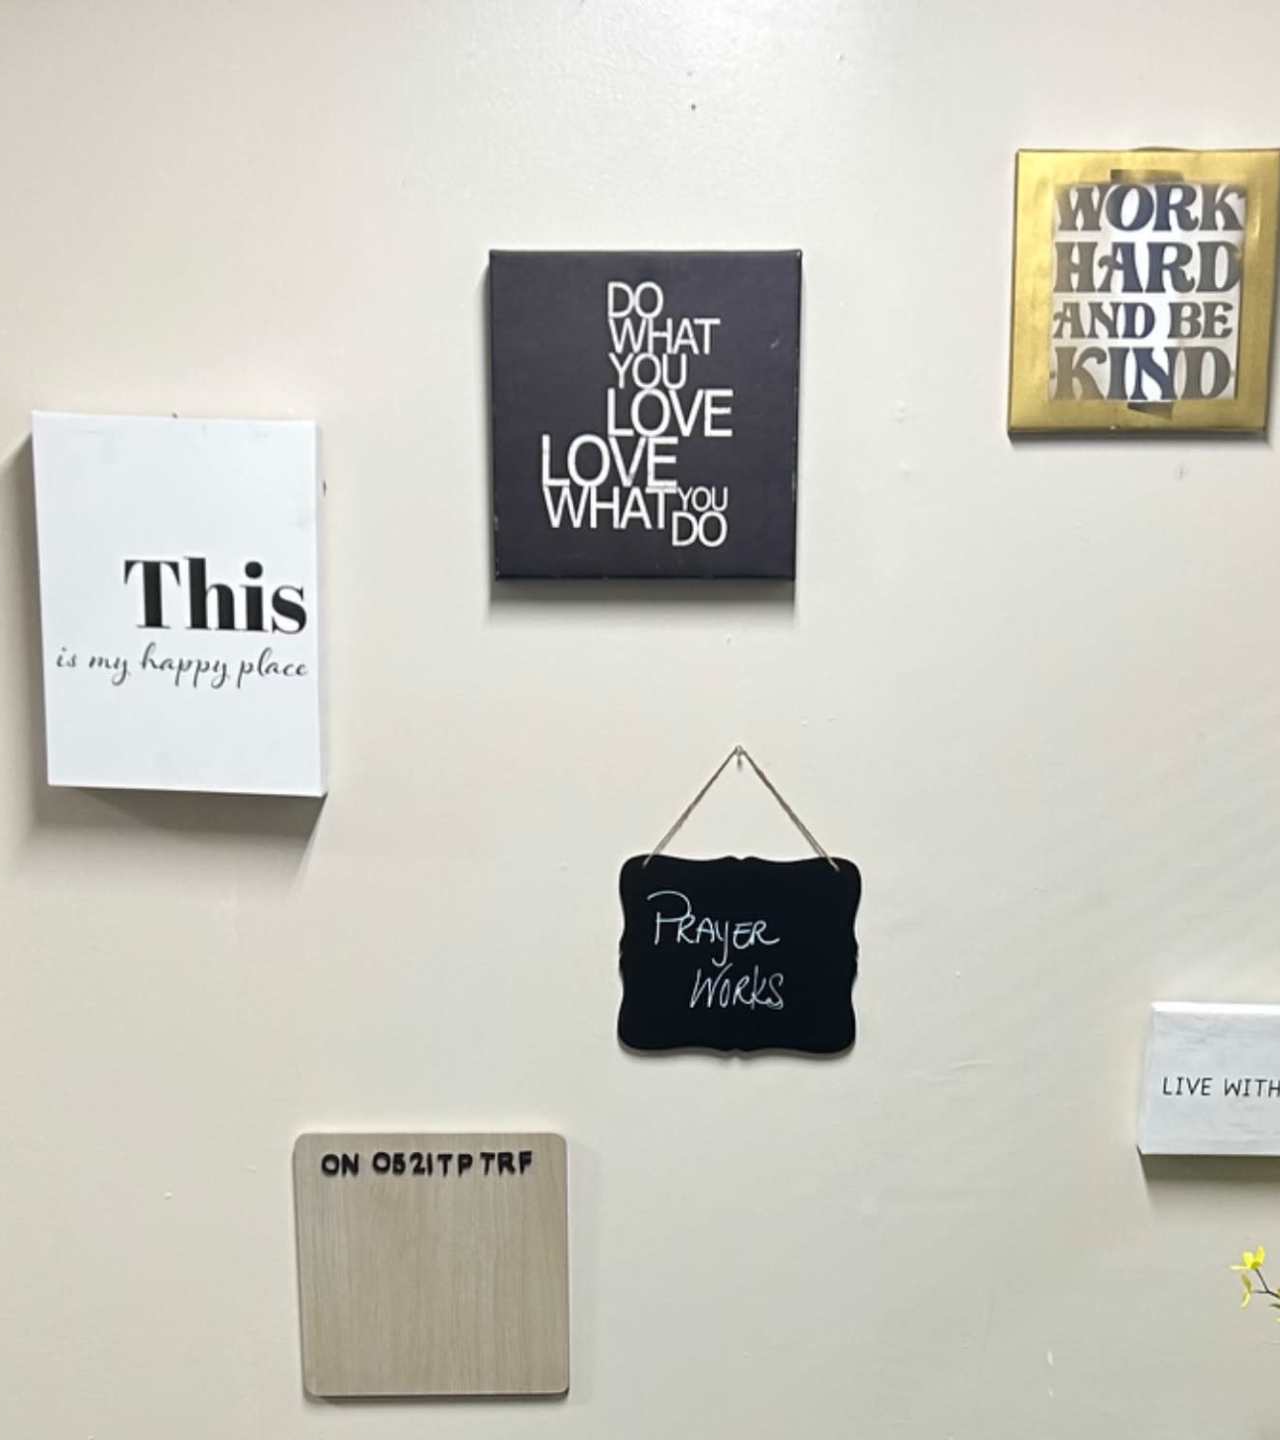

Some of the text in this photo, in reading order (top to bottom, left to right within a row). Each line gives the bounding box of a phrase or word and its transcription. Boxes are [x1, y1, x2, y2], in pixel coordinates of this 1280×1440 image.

[1053, 183, 1245, 231] WORK
[1053, 241, 1242, 293] HARD
[607, 281, 664, 319] DO
[1053, 302, 1234, 339] AND BE
[608, 318, 721, 354] WHAT
[608, 352, 687, 390] YOU
[1051, 346, 1232, 401] KIND
[607, 387, 734, 437] LOVE
[542, 434, 679, 488] LOVE
[542, 486, 728, 529] WHAT YOU
[671, 510, 728, 547] DO
[123, 556, 307, 635] This
[55, 642, 309, 690] is my happy place
[646, 889, 782, 967] PRAYER
[1162, 1075, 1213, 1097] LIVE
[321, 1153, 360, 1177] ON
